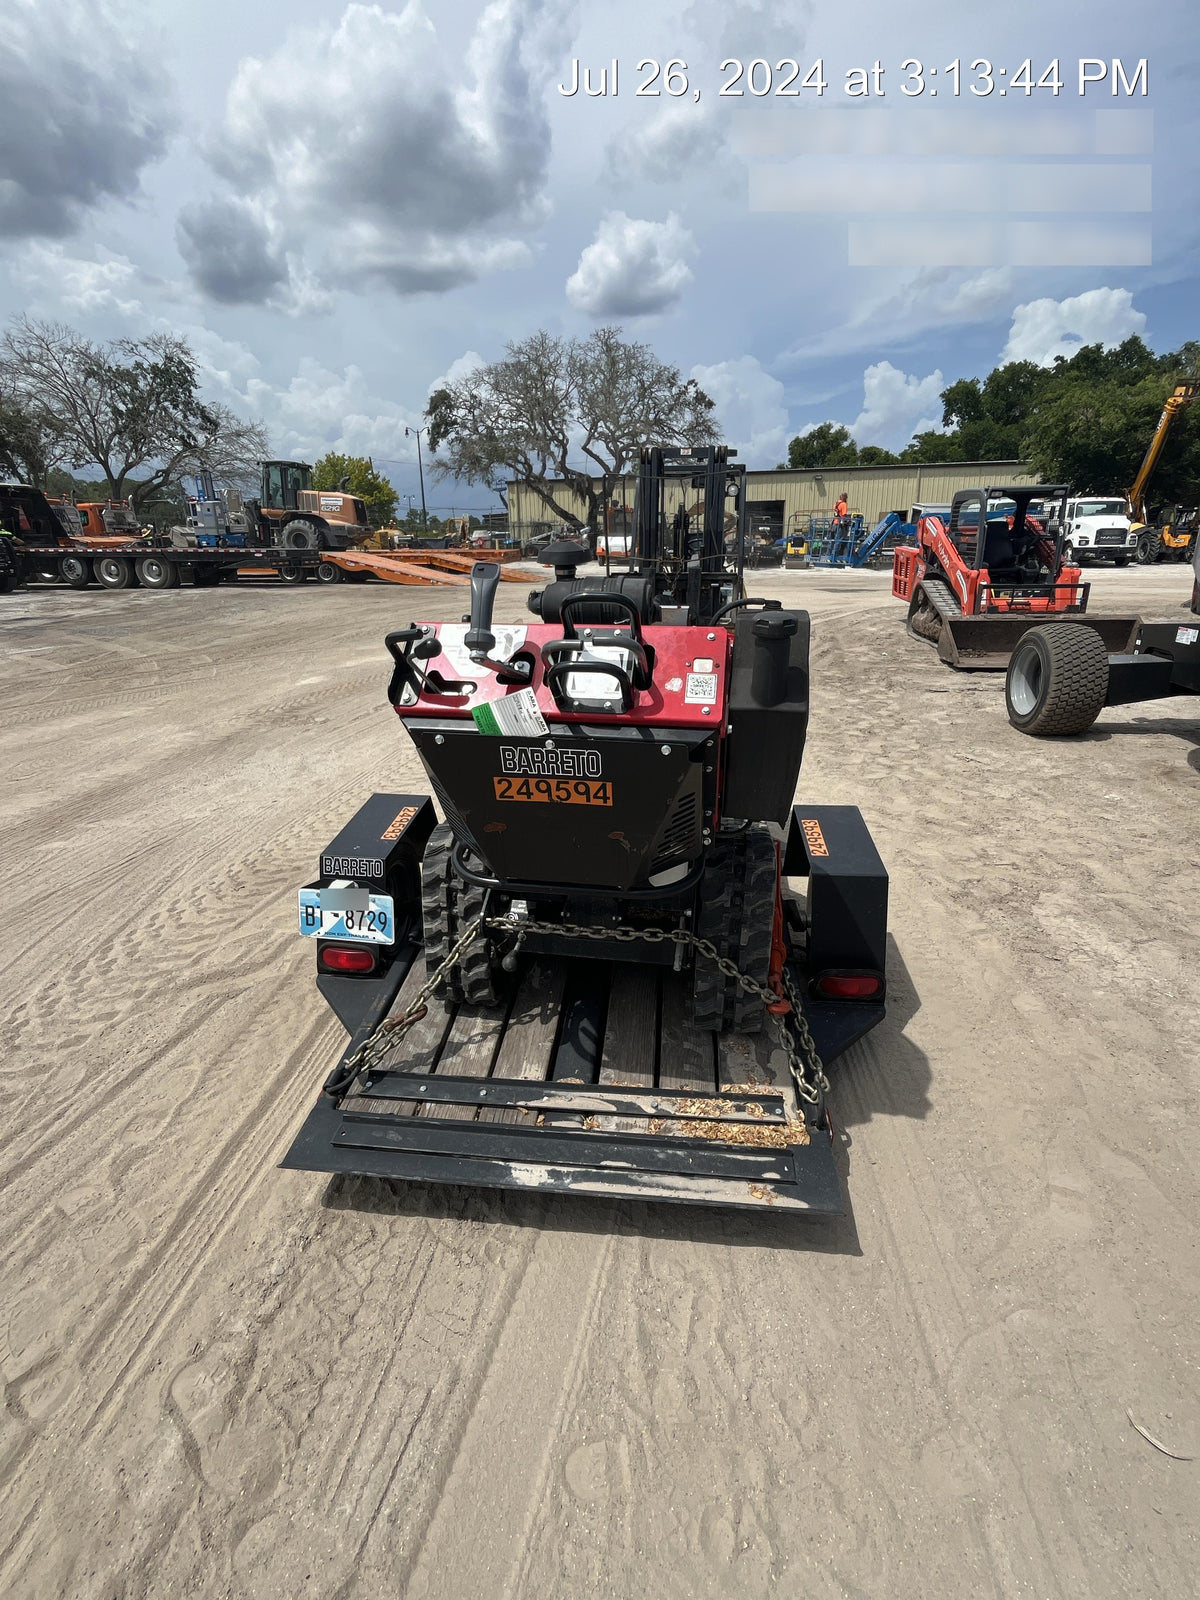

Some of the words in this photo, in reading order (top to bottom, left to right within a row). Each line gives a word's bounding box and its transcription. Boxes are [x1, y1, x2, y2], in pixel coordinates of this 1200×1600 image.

[499, 745, 602, 777] BARRETO
[496, 778, 611, 804] 249594
[383, 807, 417, 839] 249593
[802, 820, 828, 856] 249593
[323, 856, 384, 878] BARRETO
[345, 910, 387, 933] 8729
